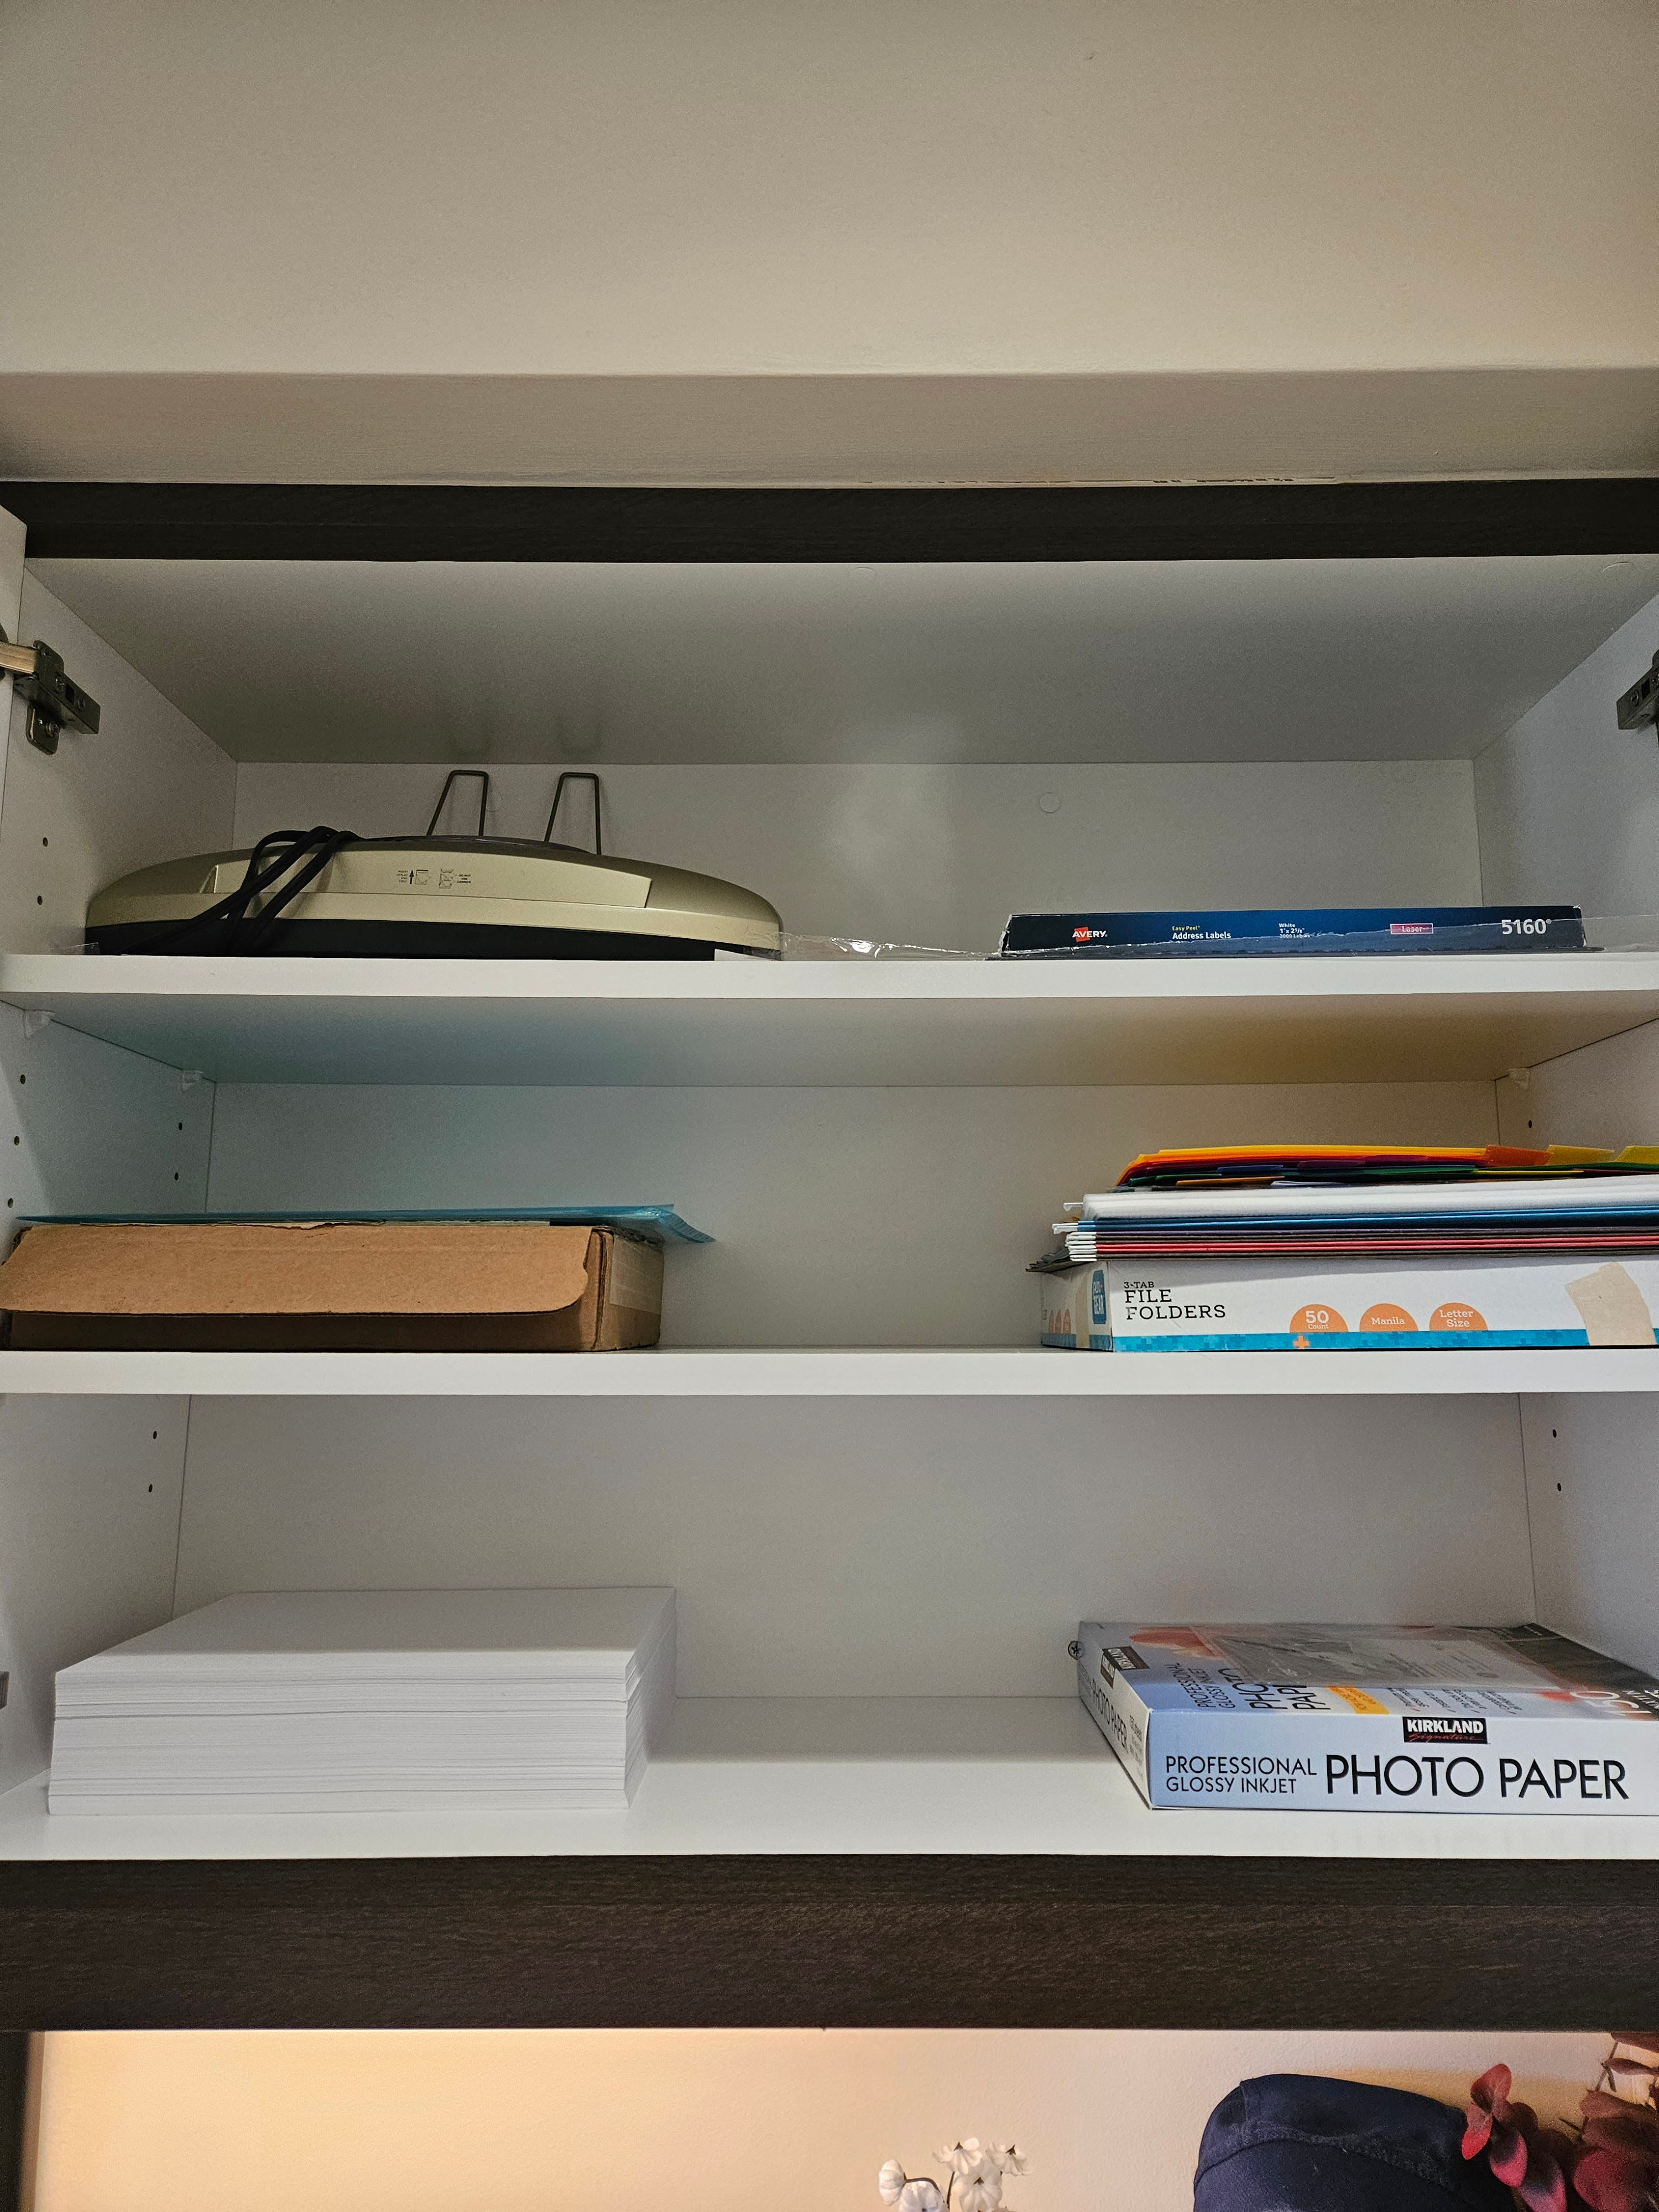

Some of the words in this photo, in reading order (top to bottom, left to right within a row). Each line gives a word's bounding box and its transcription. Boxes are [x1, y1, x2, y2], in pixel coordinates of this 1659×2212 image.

[1124, 1289, 1172, 1303] FILE
[1125, 1305, 1226, 1320] FOLDERS
[1306, 1310, 1329, 1323] 50
[1446, 1319, 1470, 1327] Size
[1164, 1662, 1217, 1708] PROFESSIONAL
[1204, 1684, 1236, 1709] GLOSSY
[1407, 1719, 1484, 1733] KIRKLAND
[1408, 1733, 1484, 1743] Signature
[1166, 1756, 1317, 1775] PROFESSIONAL
[1166, 1776, 1234, 1792] GLOSSY
[1241, 1777, 1296, 1793] INKJET
[1327, 1755, 1484, 1797] PHOTO
[1499, 1758, 1630, 1799] PAPER
